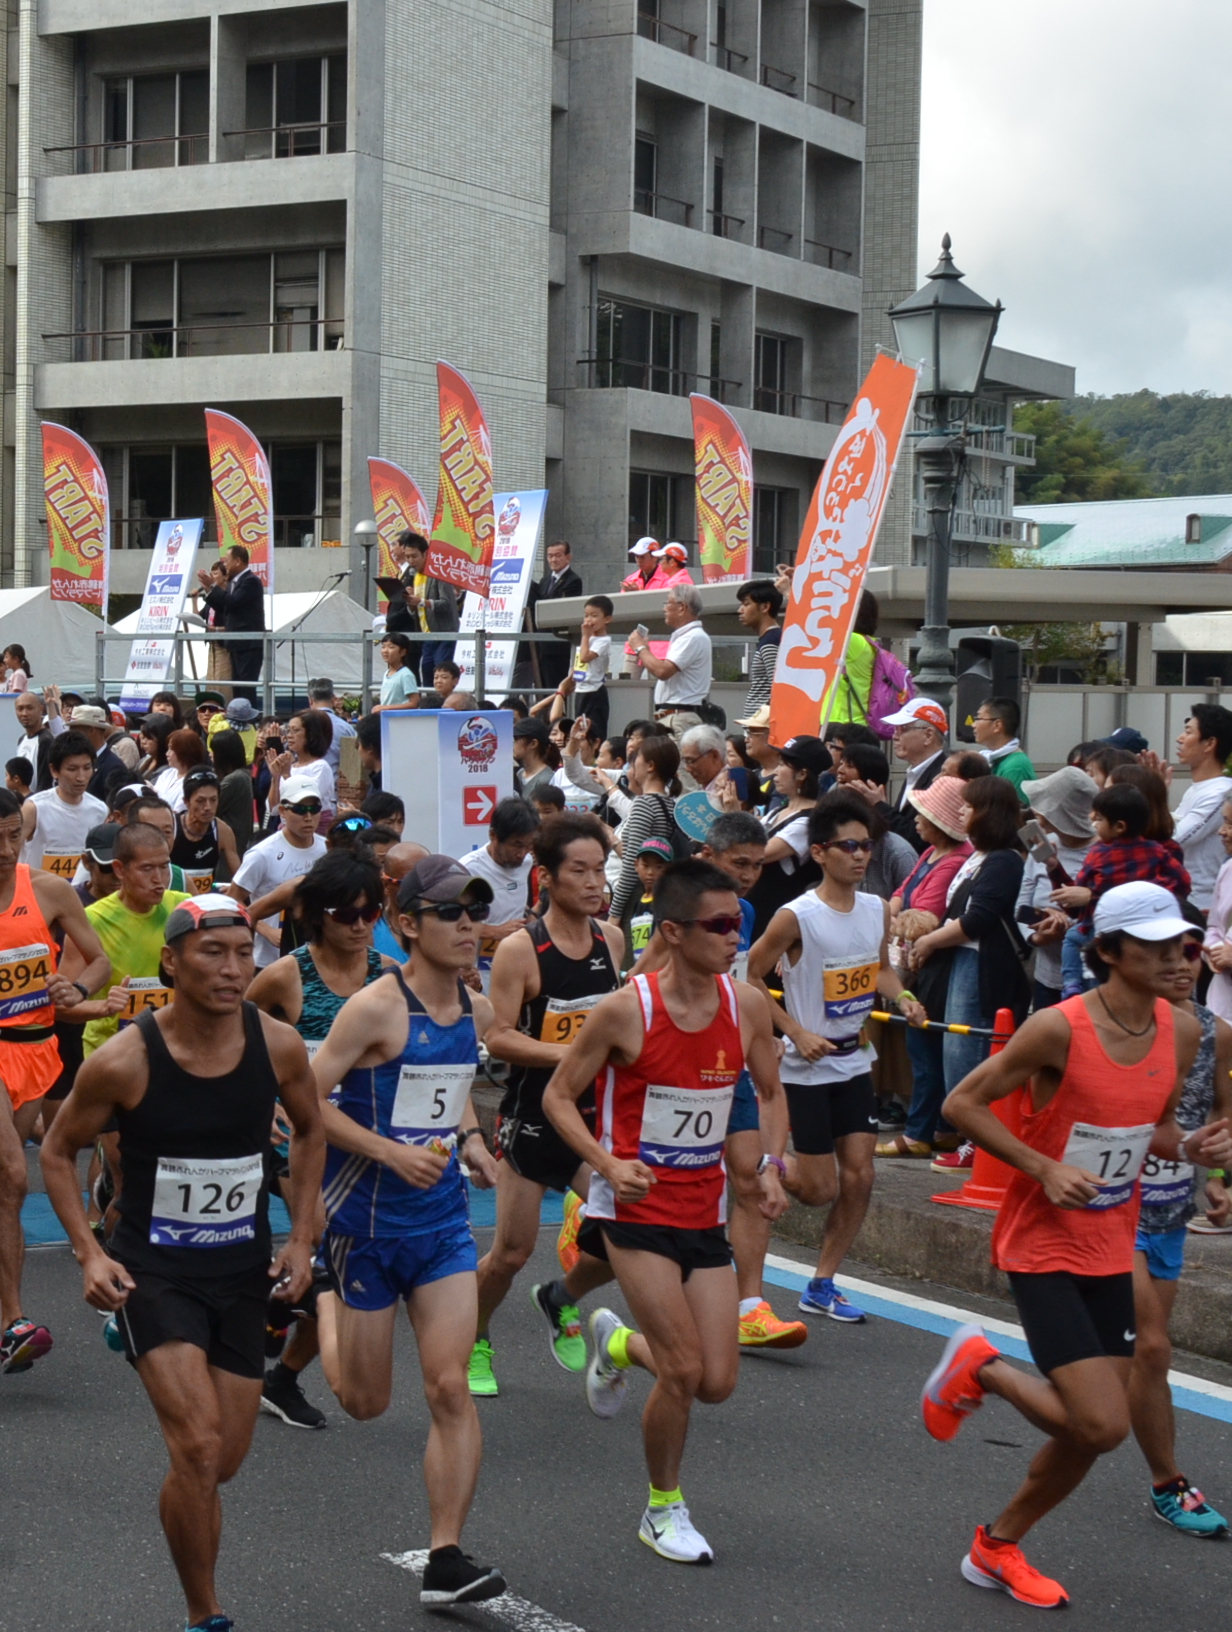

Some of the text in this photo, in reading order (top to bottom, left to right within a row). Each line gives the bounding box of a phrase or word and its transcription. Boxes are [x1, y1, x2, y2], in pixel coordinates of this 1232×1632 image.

[495, 545, 518, 557] 別協賛
[148, 606, 169, 617] KIRIN
[478, 597, 506, 611] KRIN
[468, 764, 489, 773] 2018
[836, 967, 870, 995] 366
[430, 1088, 447, 1119] 5
[672, 1109, 713, 1139] 70
[1099, 1148, 1133, 1178] 12
[177, 1180, 247, 1214] 126
